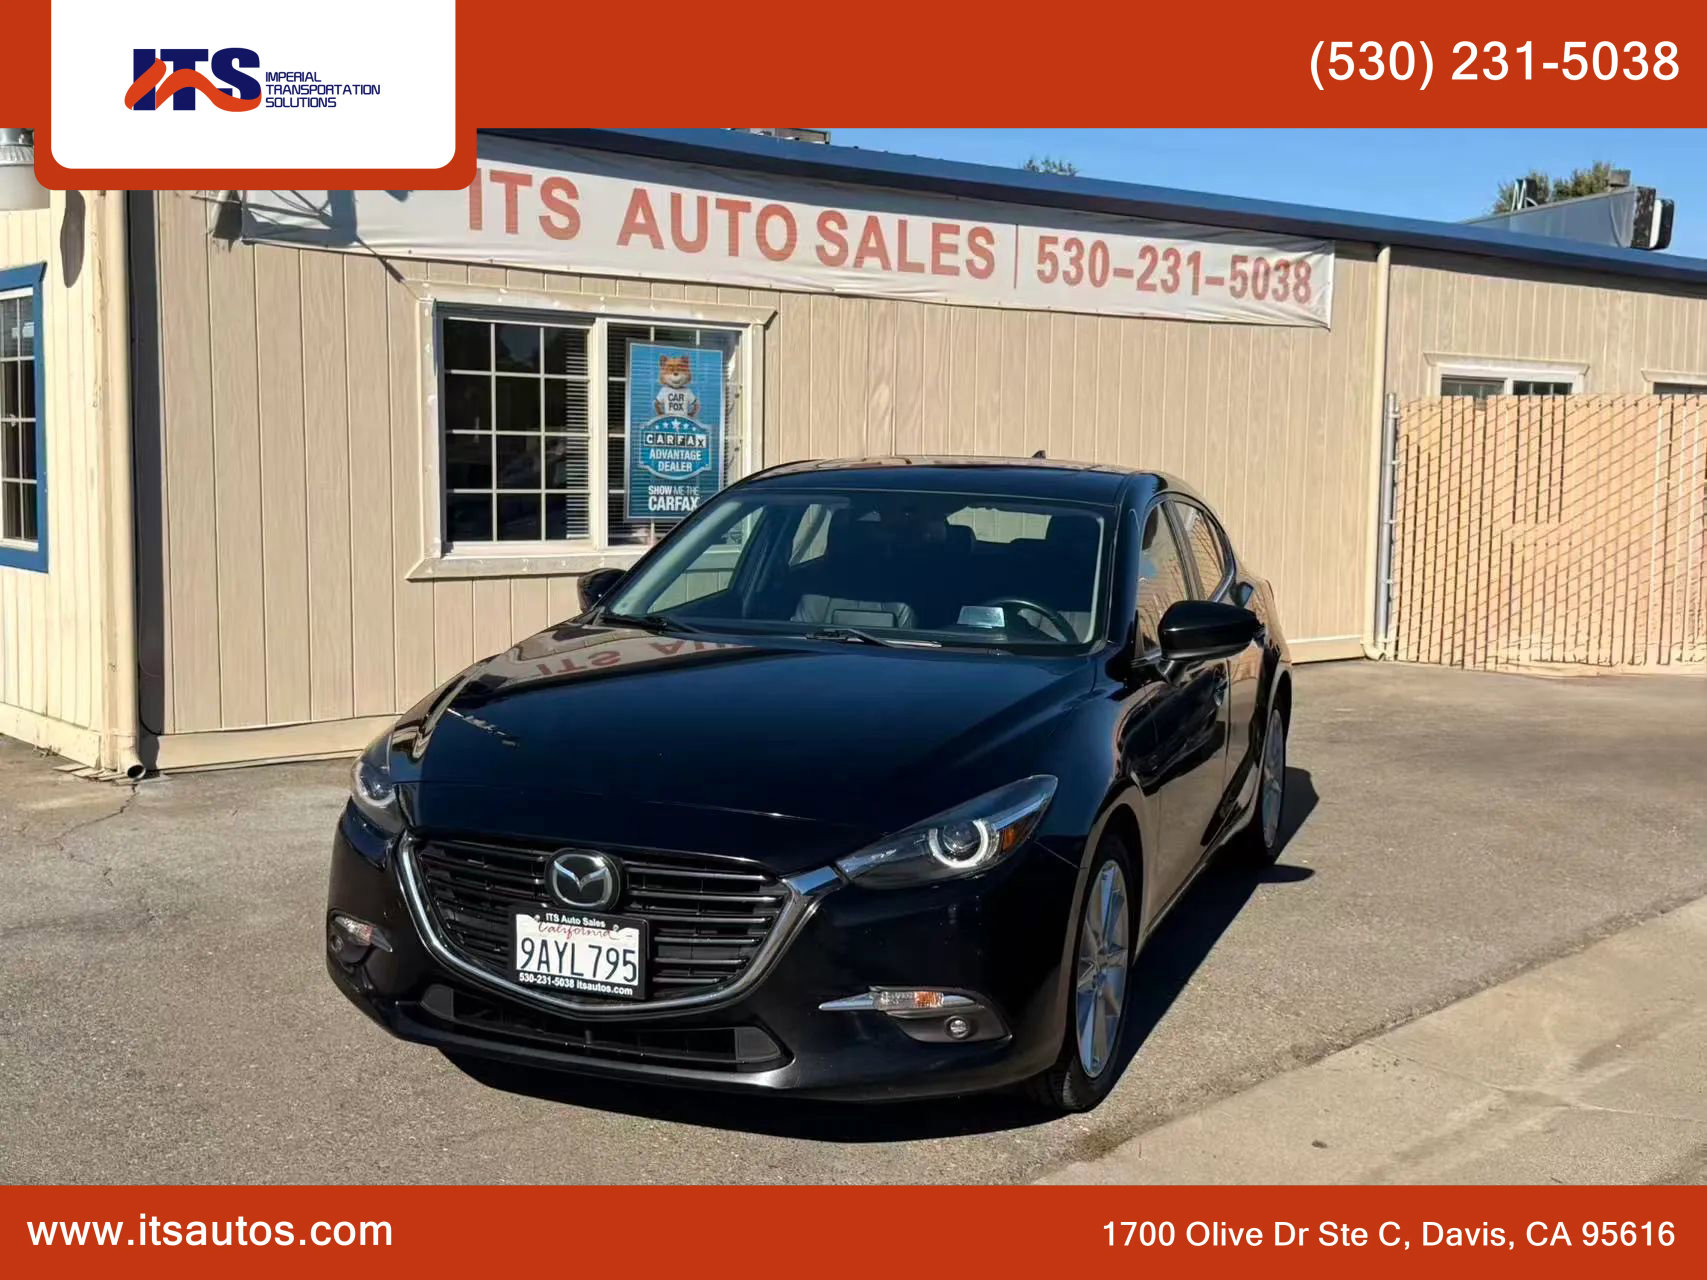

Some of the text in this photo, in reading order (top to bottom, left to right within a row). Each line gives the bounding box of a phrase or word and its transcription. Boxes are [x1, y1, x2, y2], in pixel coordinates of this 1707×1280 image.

[468, 167, 1313, 305] ITS AUTO SALES 530-231-5038
[668, 393, 685, 402] CAR
[668, 403, 685, 412] FOX
[645, 432, 706, 448] CARFAX
[649, 449, 702, 461] ADVANTAGE
[658, 461, 692, 472] DEALER
[648, 485, 699, 496] SHOW ME THE
[648, 495, 700, 512] CARFAX
[545, 913, 606, 928] ITS Auto Sales
[537, 921, 616, 940] California
[520, 937, 637, 983] 9AYL795
[519, 972, 575, 989] 530-231-5038
